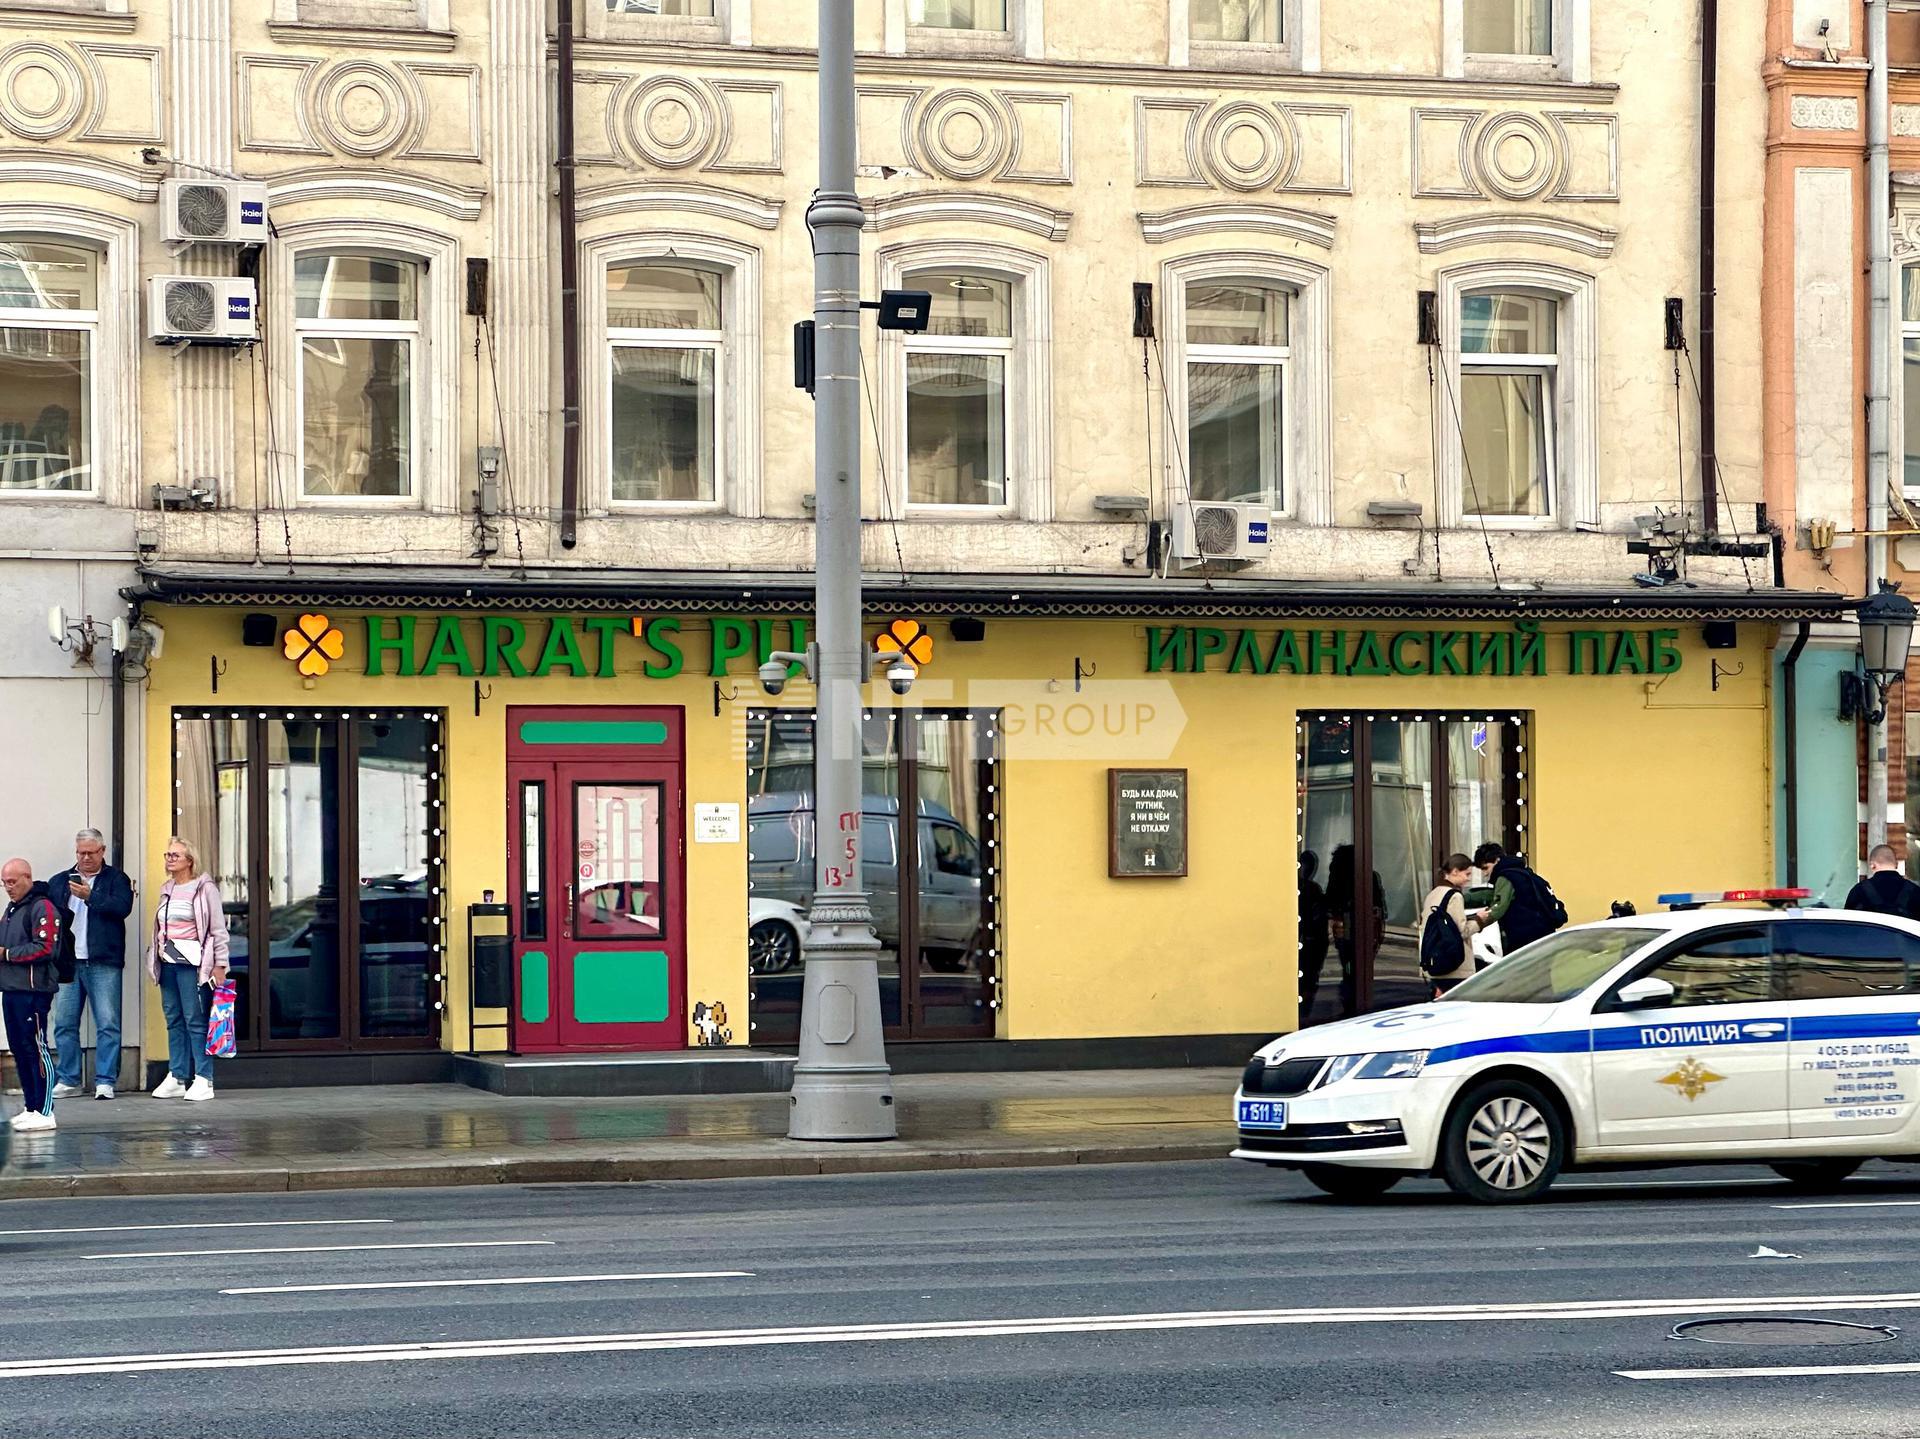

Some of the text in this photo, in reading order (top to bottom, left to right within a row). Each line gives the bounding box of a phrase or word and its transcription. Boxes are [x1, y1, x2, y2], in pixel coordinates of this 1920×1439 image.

[241, 209, 263, 218] Haier
[228, 304, 250, 313] Haier
[1249, 529, 1268, 537] Haier
[363, 615, 809, 680] HARAT'S PU
[1146, 620, 1683, 676] ИРЛАНДСКИЙ ПАБ
[1122, 789, 1179, 799] БУДЬ КАК ДОМА,
[1136, 801, 1165, 810] ПУТНИК,
[1130, 813, 1136, 821] Я
[1137, 813, 1147, 821] НИ
[1148, 813, 1153, 821] В
[1131, 825, 1170, 833] НЕ ОТКАЖУ
[846, 838, 856, 859] 5
[1640, 1024, 1740, 1044] ПОЛИЦИЯ
[1875, 1043, 1910, 1055] ГИБДД
[1250, 1103, 1270, 1121] 1511
